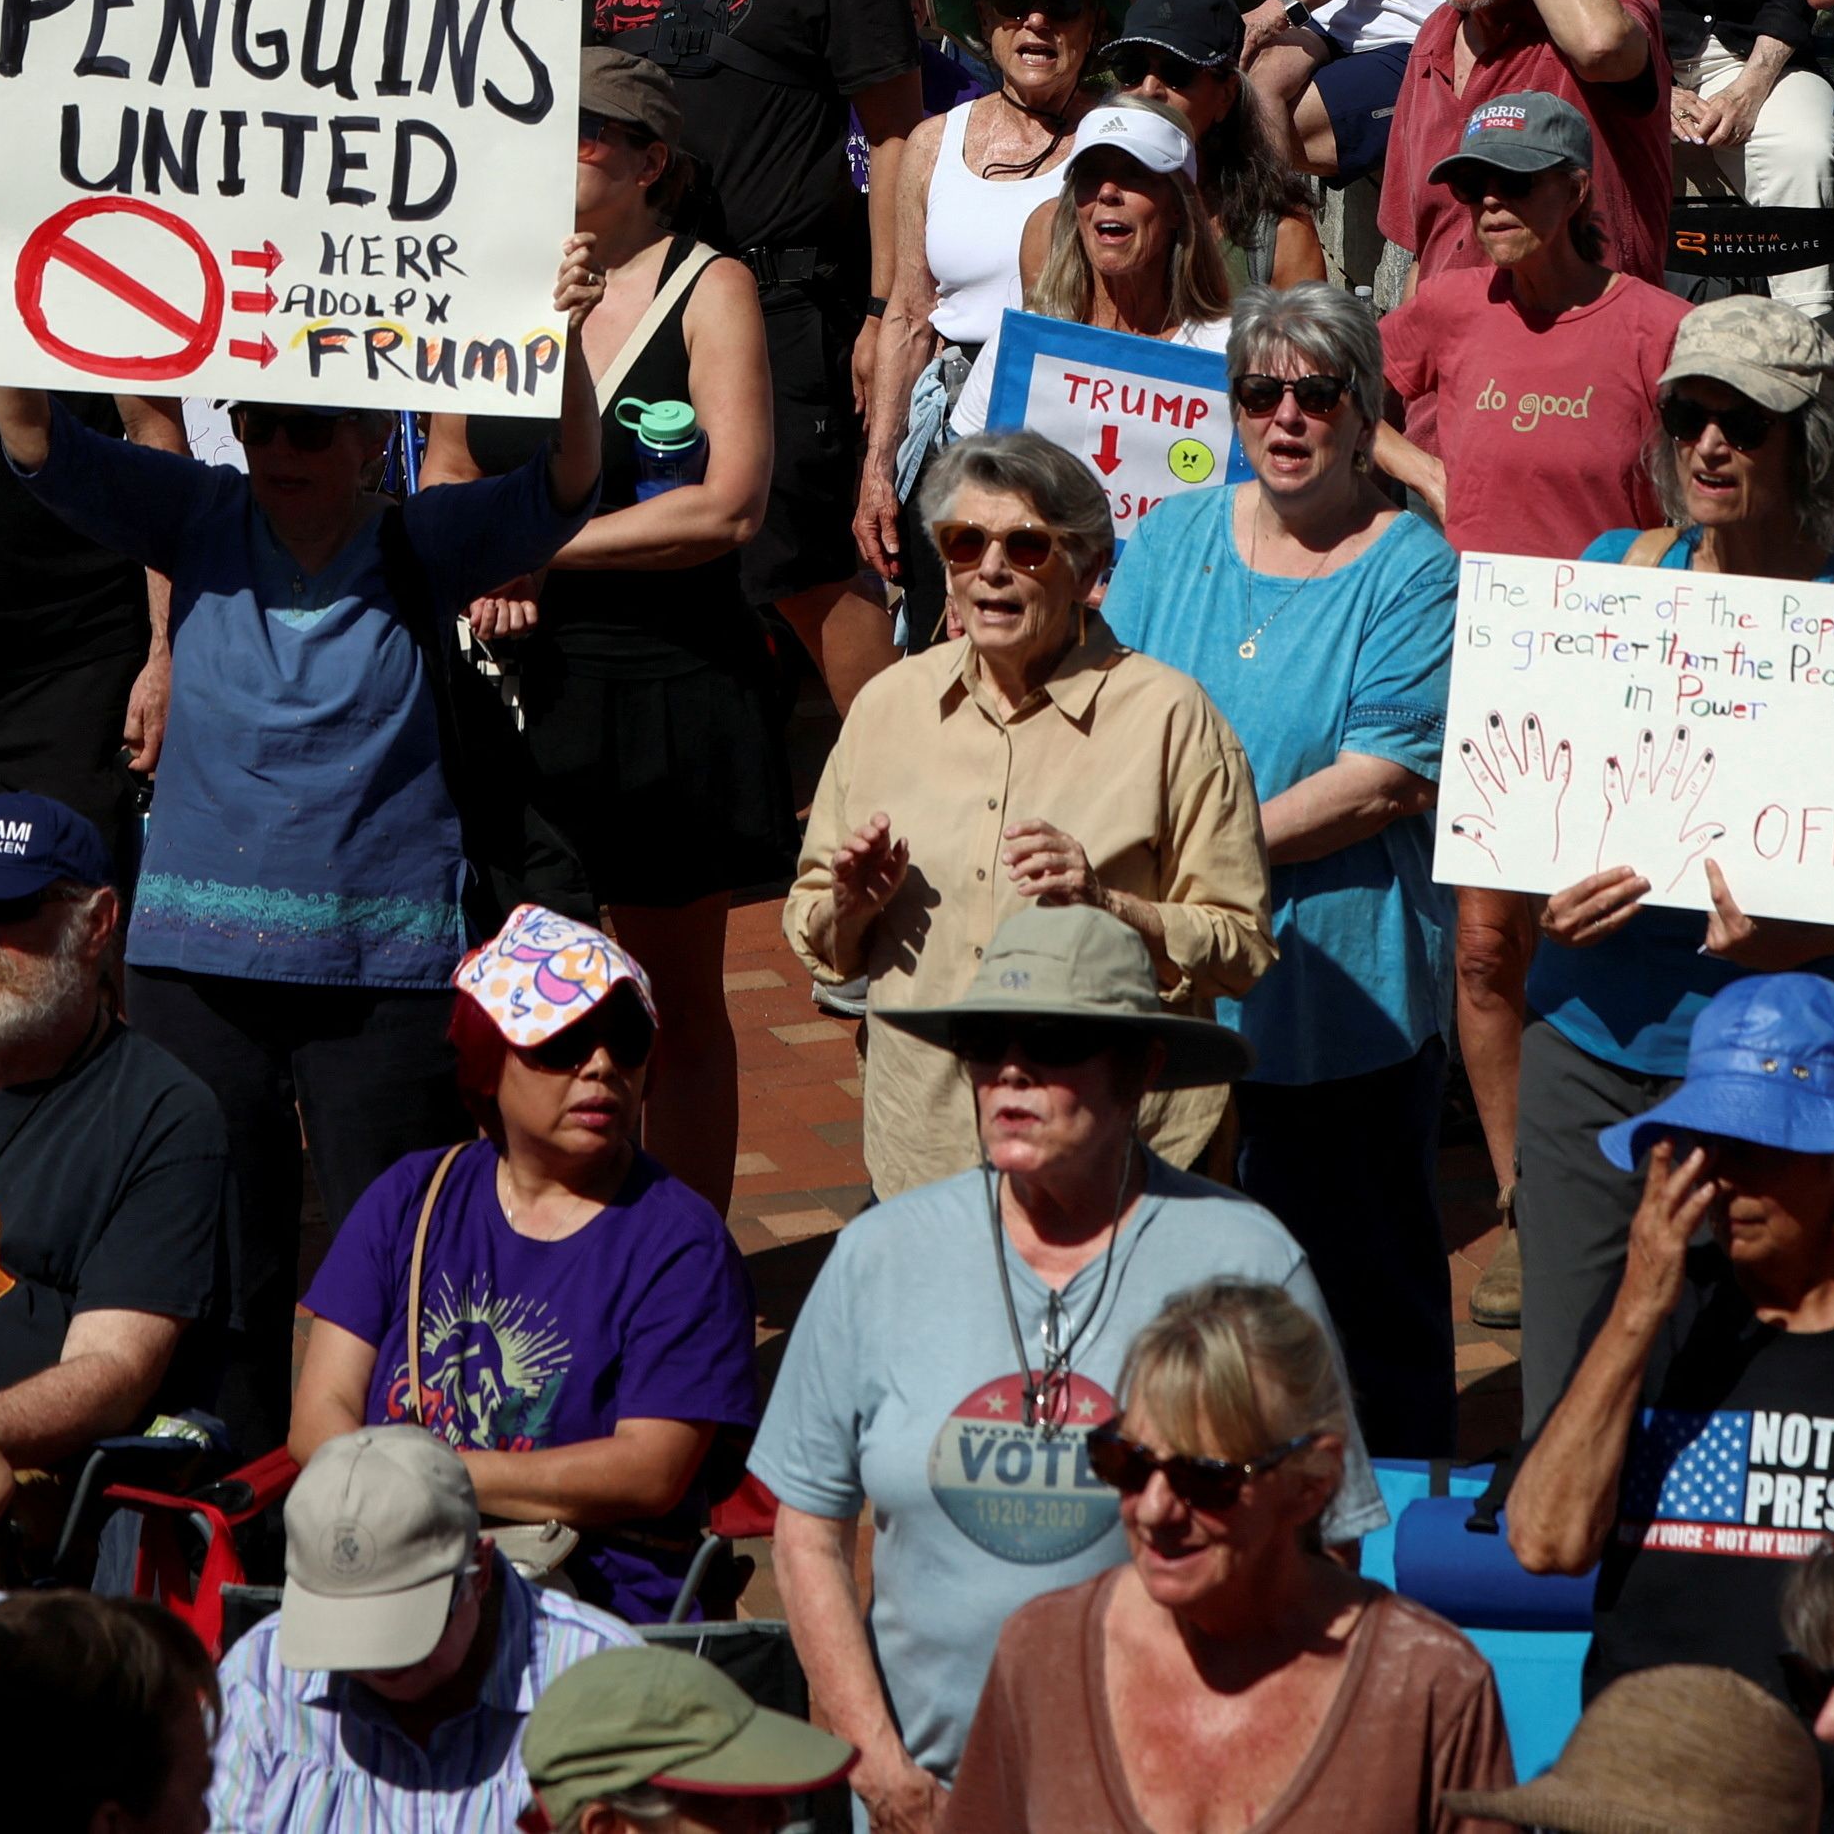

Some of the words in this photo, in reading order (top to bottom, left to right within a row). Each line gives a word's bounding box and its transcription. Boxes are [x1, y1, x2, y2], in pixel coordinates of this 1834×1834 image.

[1486, 118, 1514, 127] 2024
[59, 104, 457, 222] UNITED
[320, 231, 468, 282] HERR
[307, 326, 561, 396] FRUMP
[1476, 379, 1507, 409] do
[1513, 385, 1593, 432] good
[1467, 559, 1528, 606] The
[1554, 566, 1641, 614] Power
[1706, 591, 1757, 629] the
